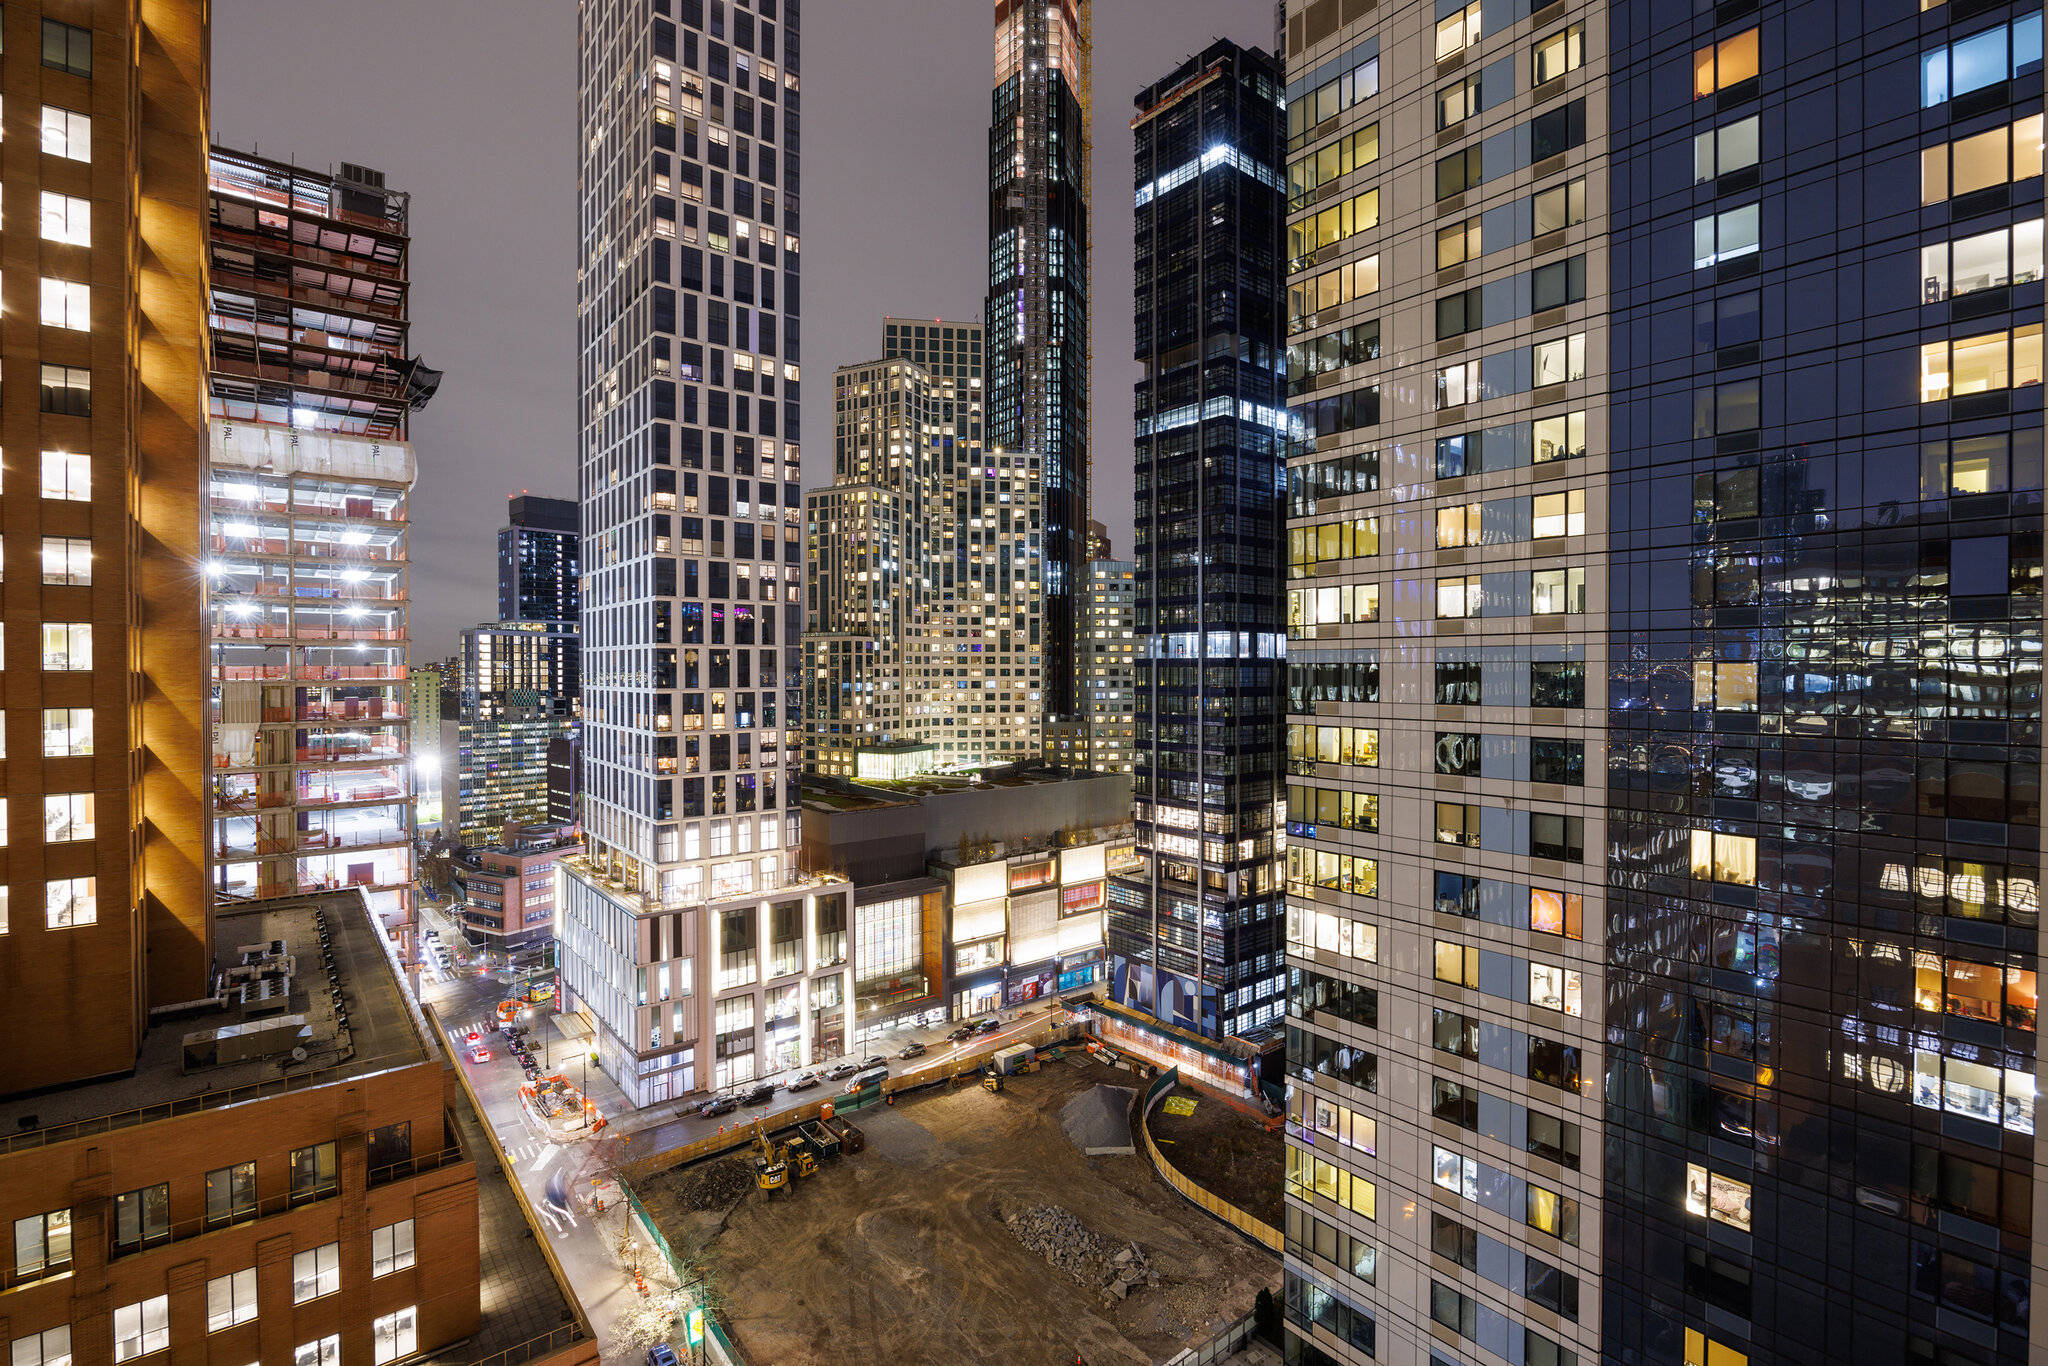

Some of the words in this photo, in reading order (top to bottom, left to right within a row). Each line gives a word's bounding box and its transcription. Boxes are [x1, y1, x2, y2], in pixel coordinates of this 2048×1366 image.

[224, 427, 232, 440] PAL
[289, 434, 299, 448] PAL
[372, 444, 380, 457] PAL
[770, 1175, 781, 1184] CAT
